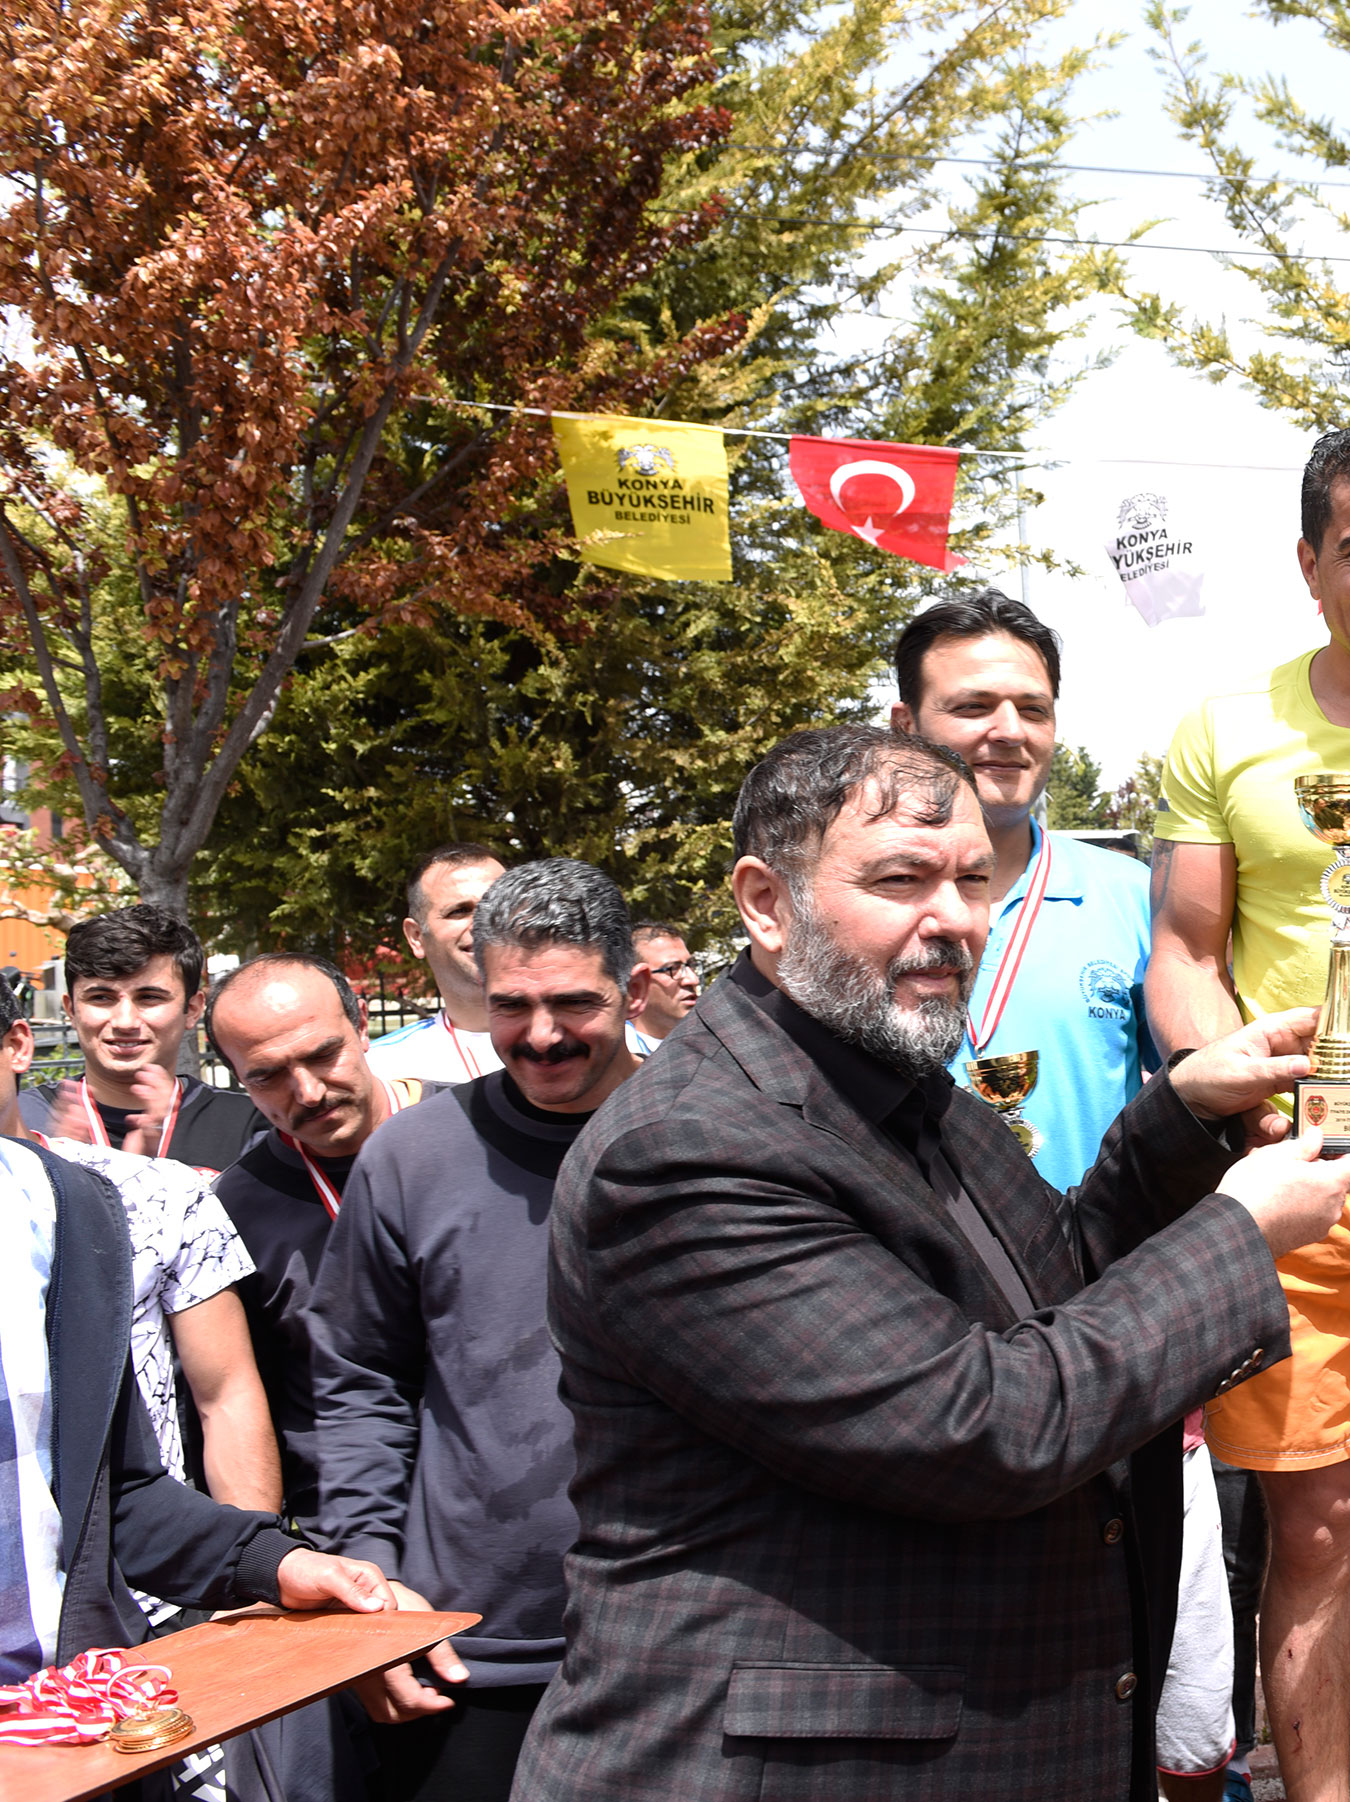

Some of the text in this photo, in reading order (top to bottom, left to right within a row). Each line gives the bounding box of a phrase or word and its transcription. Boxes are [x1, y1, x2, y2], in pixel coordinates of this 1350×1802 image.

[617, 477, 684, 491] KONYA
[587, 489, 715, 515] BÜYÜKŞEHİR
[614, 510, 691, 525] BELEDİYESİ
[1116, 528, 1168, 550] KONYA
[1112, 540, 1193, 570] YÜKŞEHİR
[1120, 560, 1170, 582] ELEDİYESİ
[1088, 1006, 1127, 1021] KONYA
